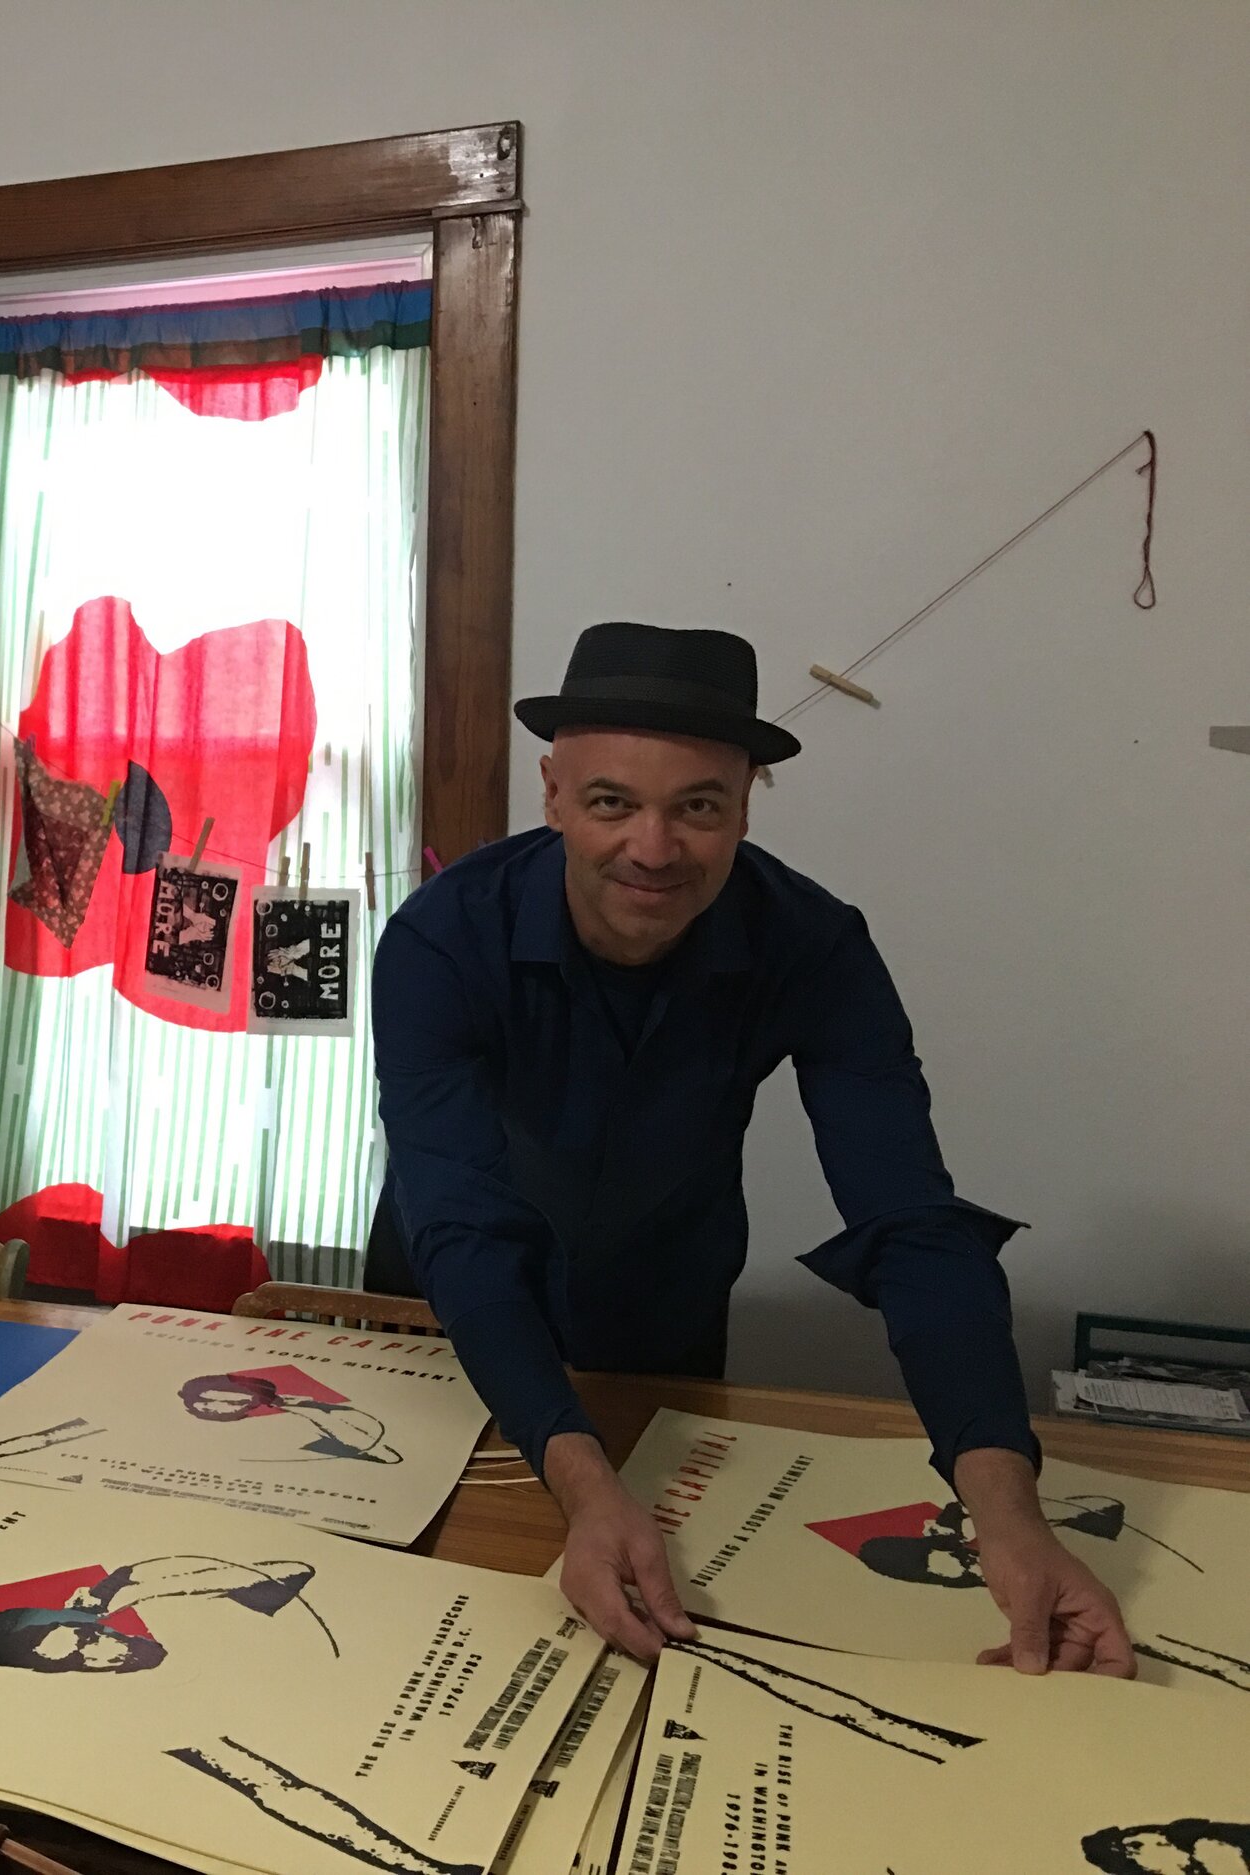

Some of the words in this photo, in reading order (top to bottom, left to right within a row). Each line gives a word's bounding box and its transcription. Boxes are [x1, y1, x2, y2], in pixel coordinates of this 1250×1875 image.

[151, 880, 176, 957] MORE
[317, 922, 342, 1001] MORE
[127, 1311, 227, 1331] PUNK
[244, 1325, 314, 1342] THE
[142, 1330, 236, 1349] BUILDING
[265, 1349, 333, 1363] SOUND
[341, 1361, 457, 1383] MOVEMENT
[140, 1469, 263, 1490] WASHINGTON
[174, 1468, 223, 1479] PUNK
[274, 1483, 378, 1504] HARDCORE
[664, 1431, 738, 1502] CAPITAL
[767, 1454, 815, 1502] MOVEMENT
[741, 1502, 776, 1533] SOUND
[733, 1534, 751, 1543] A
[690, 1544, 741, 1588] BUILDING
[354, 1754, 379, 1778] THE
[371, 1721, 397, 1749] RISE
[399, 1671, 426, 1700] PUNK
[421, 1649, 438, 1667] AND
[431, 1594, 470, 1646] HARDCORE
[398, 1728, 416, 1741] IN
[408, 1651, 459, 1722] WASHINGTON
[778, 1724, 793, 1748] THE
[754, 1762, 769, 1777] IN
[776, 1754, 793, 1786] RISE
[775, 1813, 791, 1853] PUNK
